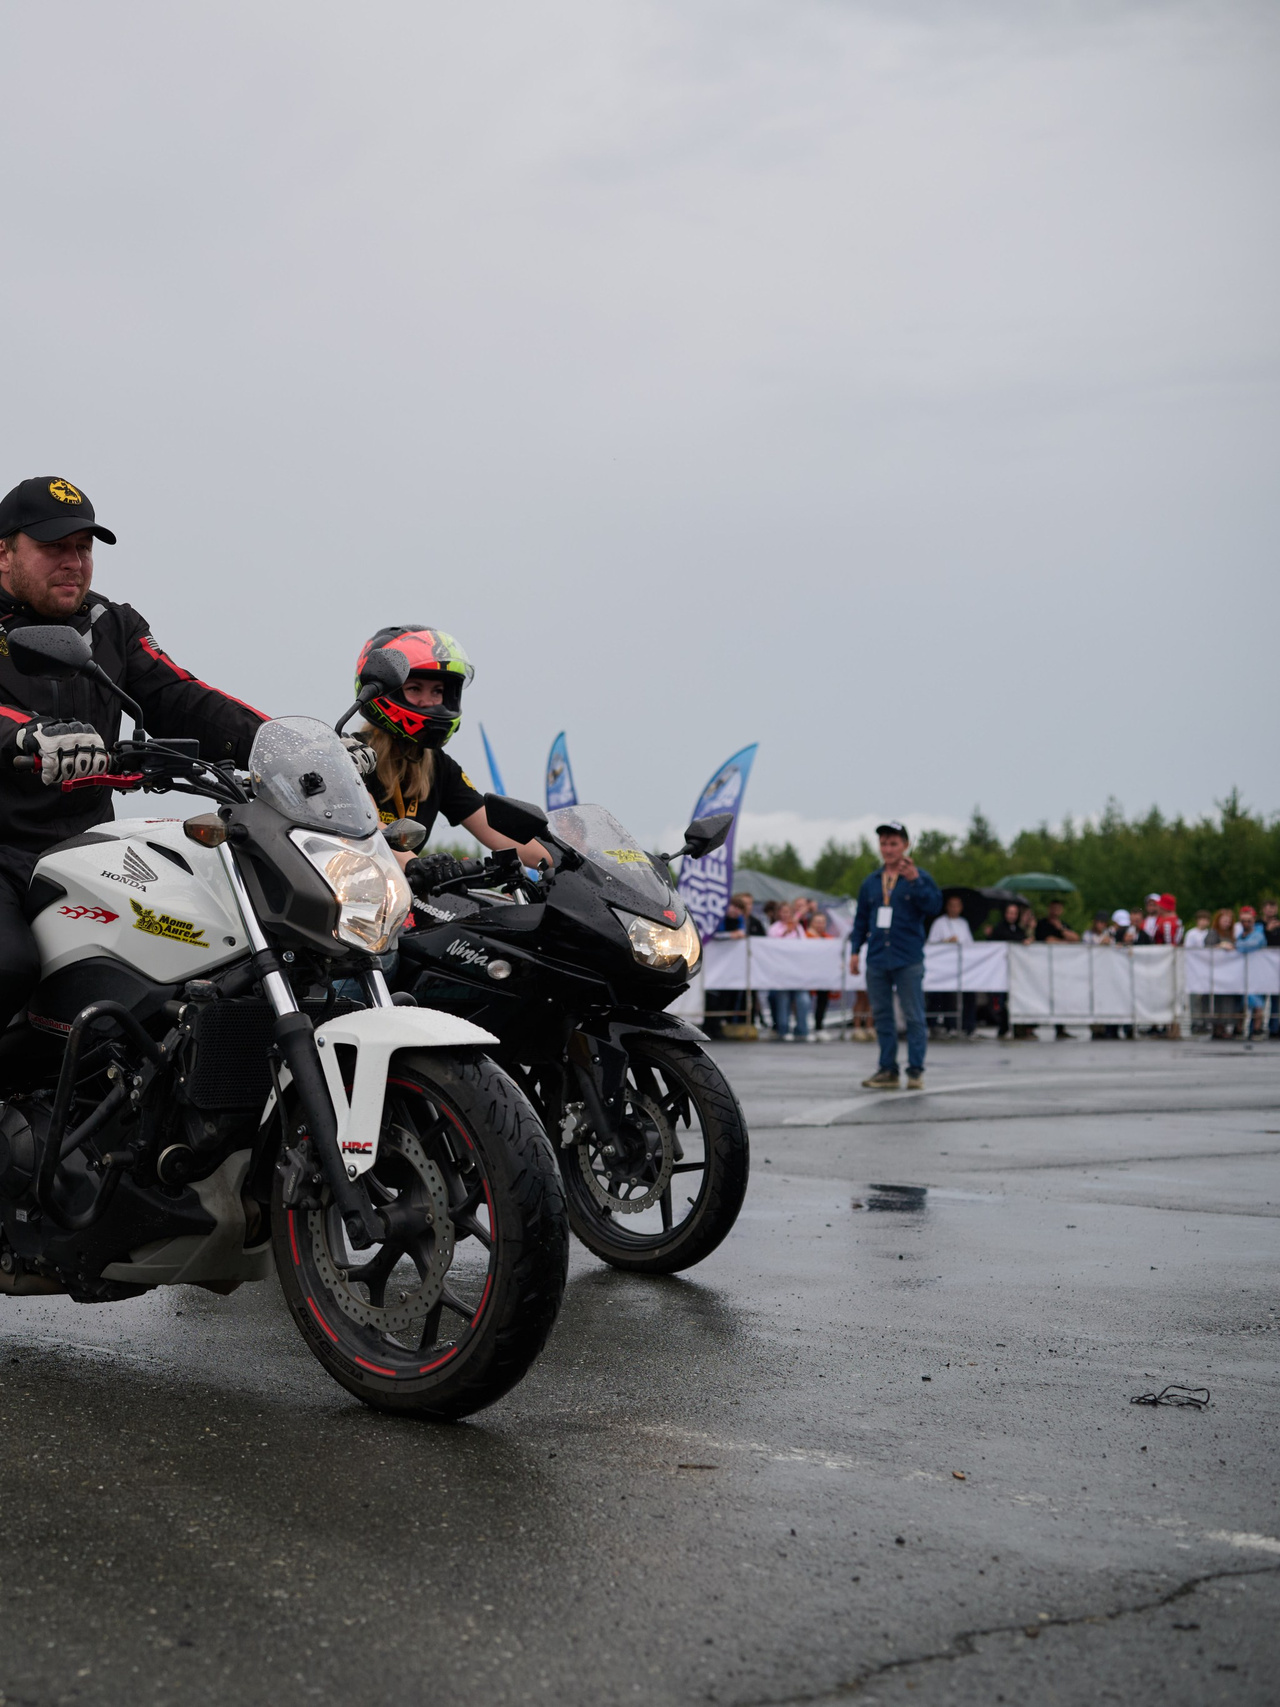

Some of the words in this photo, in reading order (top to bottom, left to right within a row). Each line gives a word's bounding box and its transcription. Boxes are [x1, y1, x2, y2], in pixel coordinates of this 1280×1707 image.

[101, 870, 147, 893] HONDA
[412, 896, 456, 922] awasaki
[446, 939, 489, 967] Ninja
[342, 1141, 373, 1154] HRC
